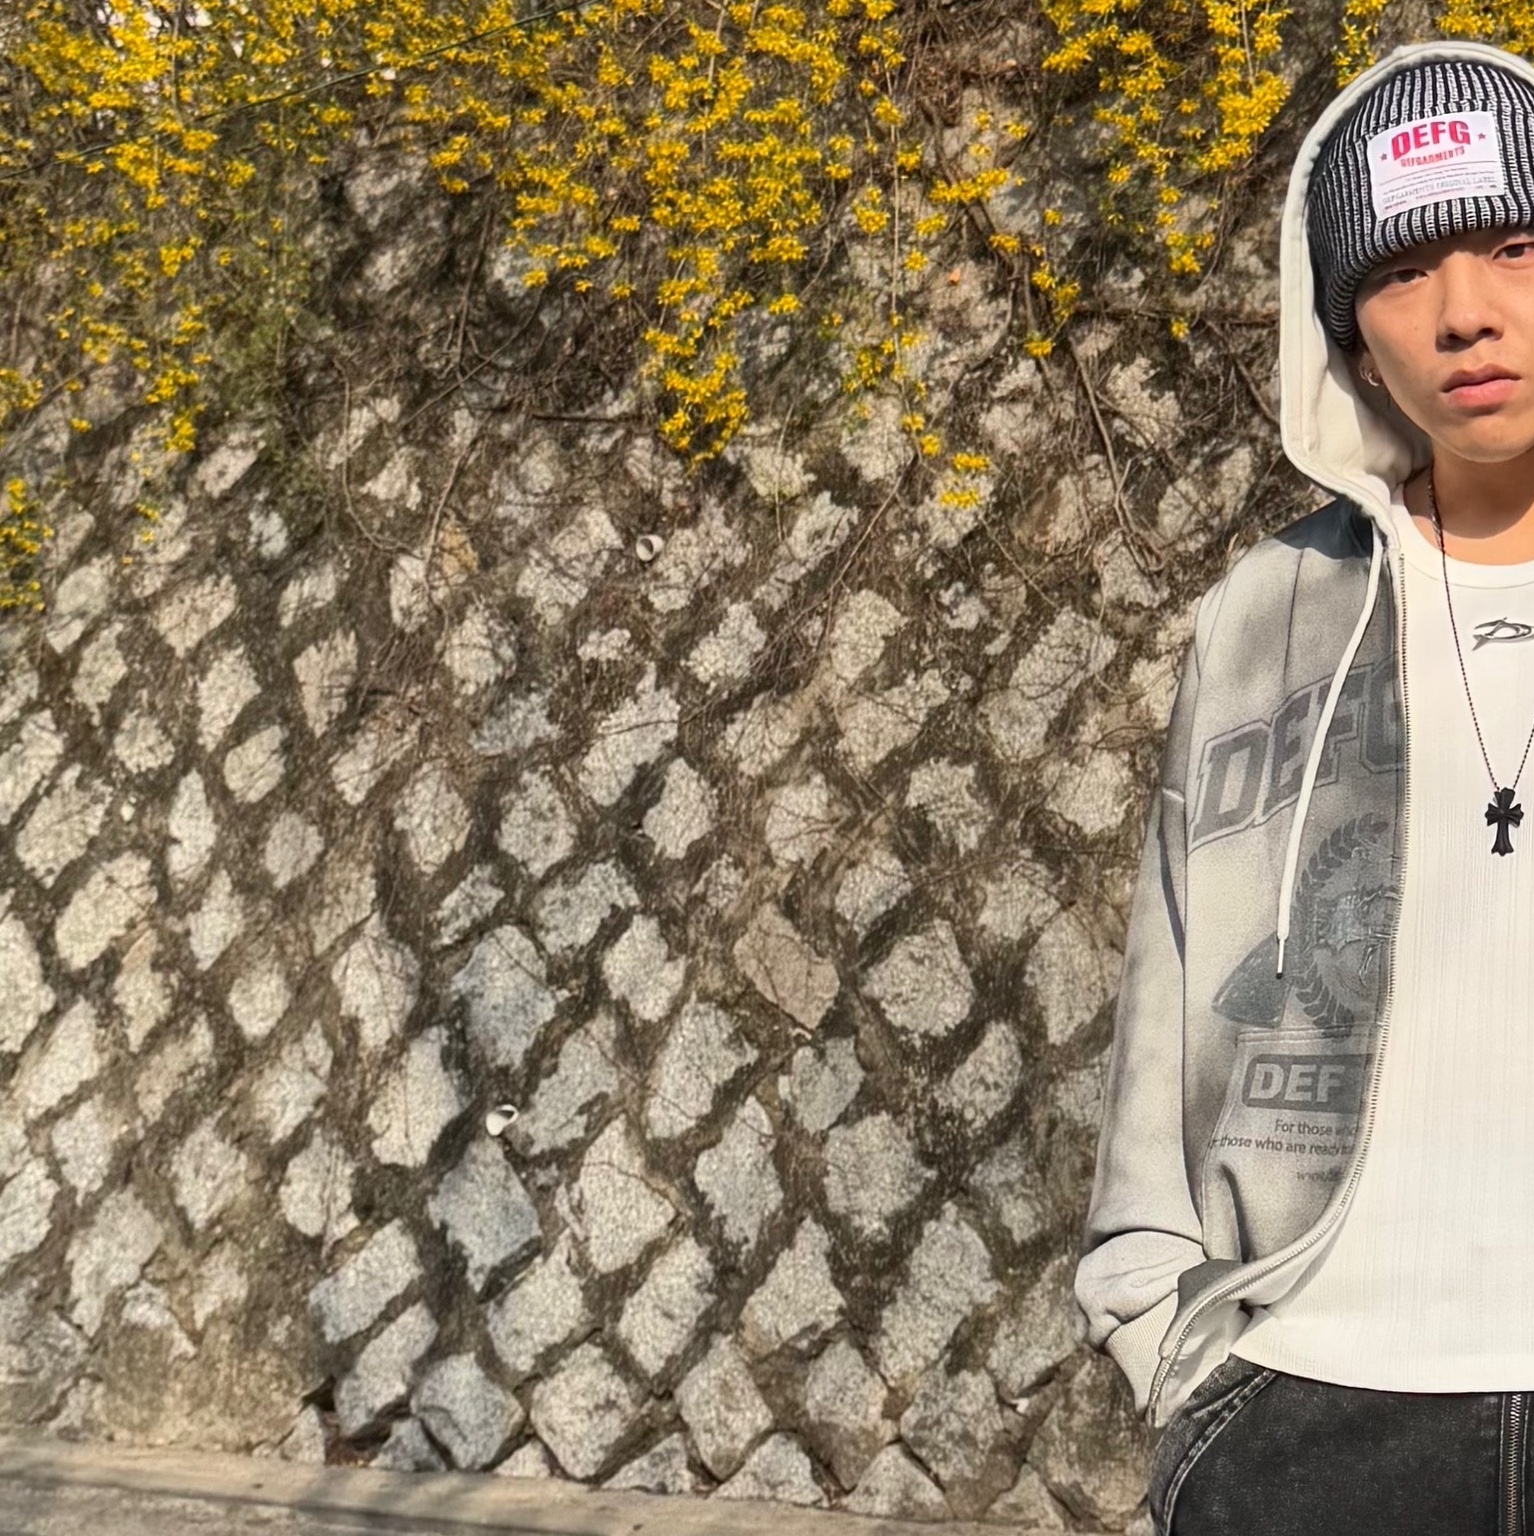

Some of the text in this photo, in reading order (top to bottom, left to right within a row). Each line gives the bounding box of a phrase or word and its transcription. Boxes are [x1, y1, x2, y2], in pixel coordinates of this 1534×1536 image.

[1391, 120, 1471, 161] DEFG
[1248, 1062, 1346, 1103] DEF
[1275, 1118, 1294, 1134] For
[1298, 1120, 1333, 1137] those
[1219, 1134, 1253, 1149] those
[1254, 1136, 1283, 1152] who
[1285, 1141, 1307, 1155] are
